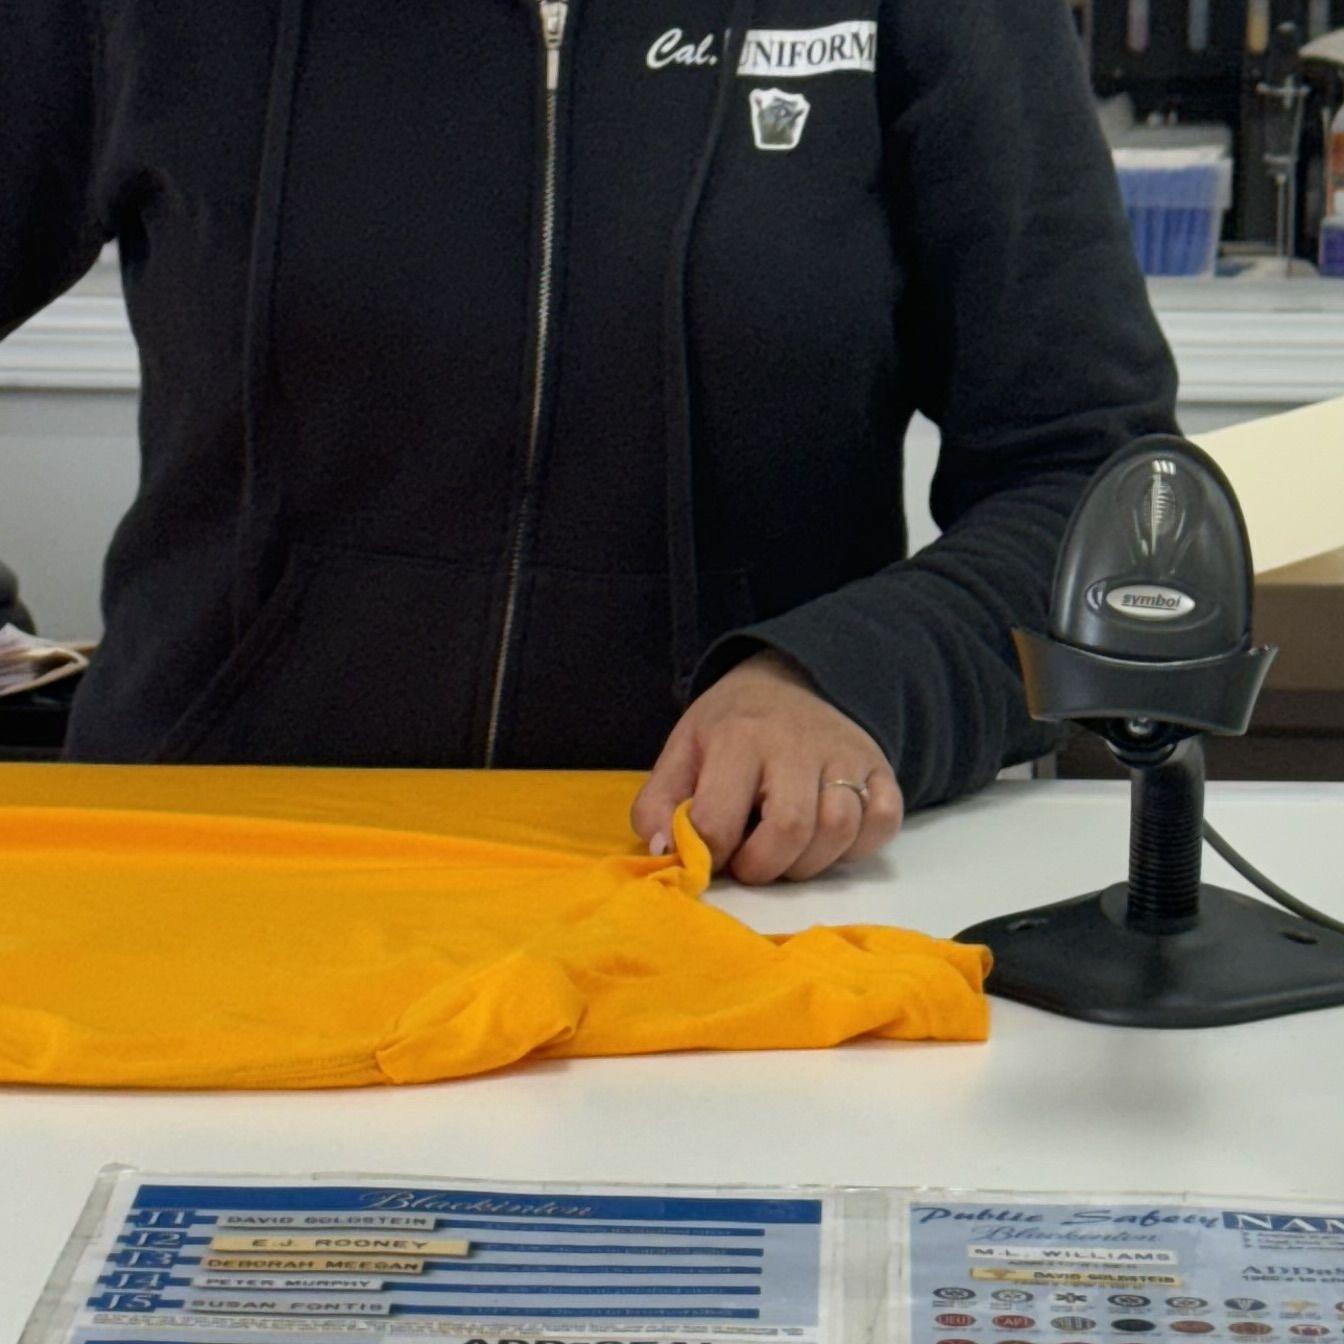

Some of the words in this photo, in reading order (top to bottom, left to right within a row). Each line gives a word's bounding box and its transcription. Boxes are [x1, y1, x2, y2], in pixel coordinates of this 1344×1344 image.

[646, 27, 718, 69] Cal.
[1121, 592, 1182, 607] symbol
[227, 1216, 294, 1225] DAVID
[304, 1216, 427, 1226] GOLDSTEIN
[912, 1207, 1044, 1224] Public
[1060, 1209, 1219, 1229] Safety
[315, 1239, 429, 1250] ROONEY
[1042, 1250, 1171, 1261] WILLIAMS
[207, 1259, 314, 1269] DEBORAH
[107, 1293, 153, 1309] J5
[191, 1300, 276, 1310] SUSAN
